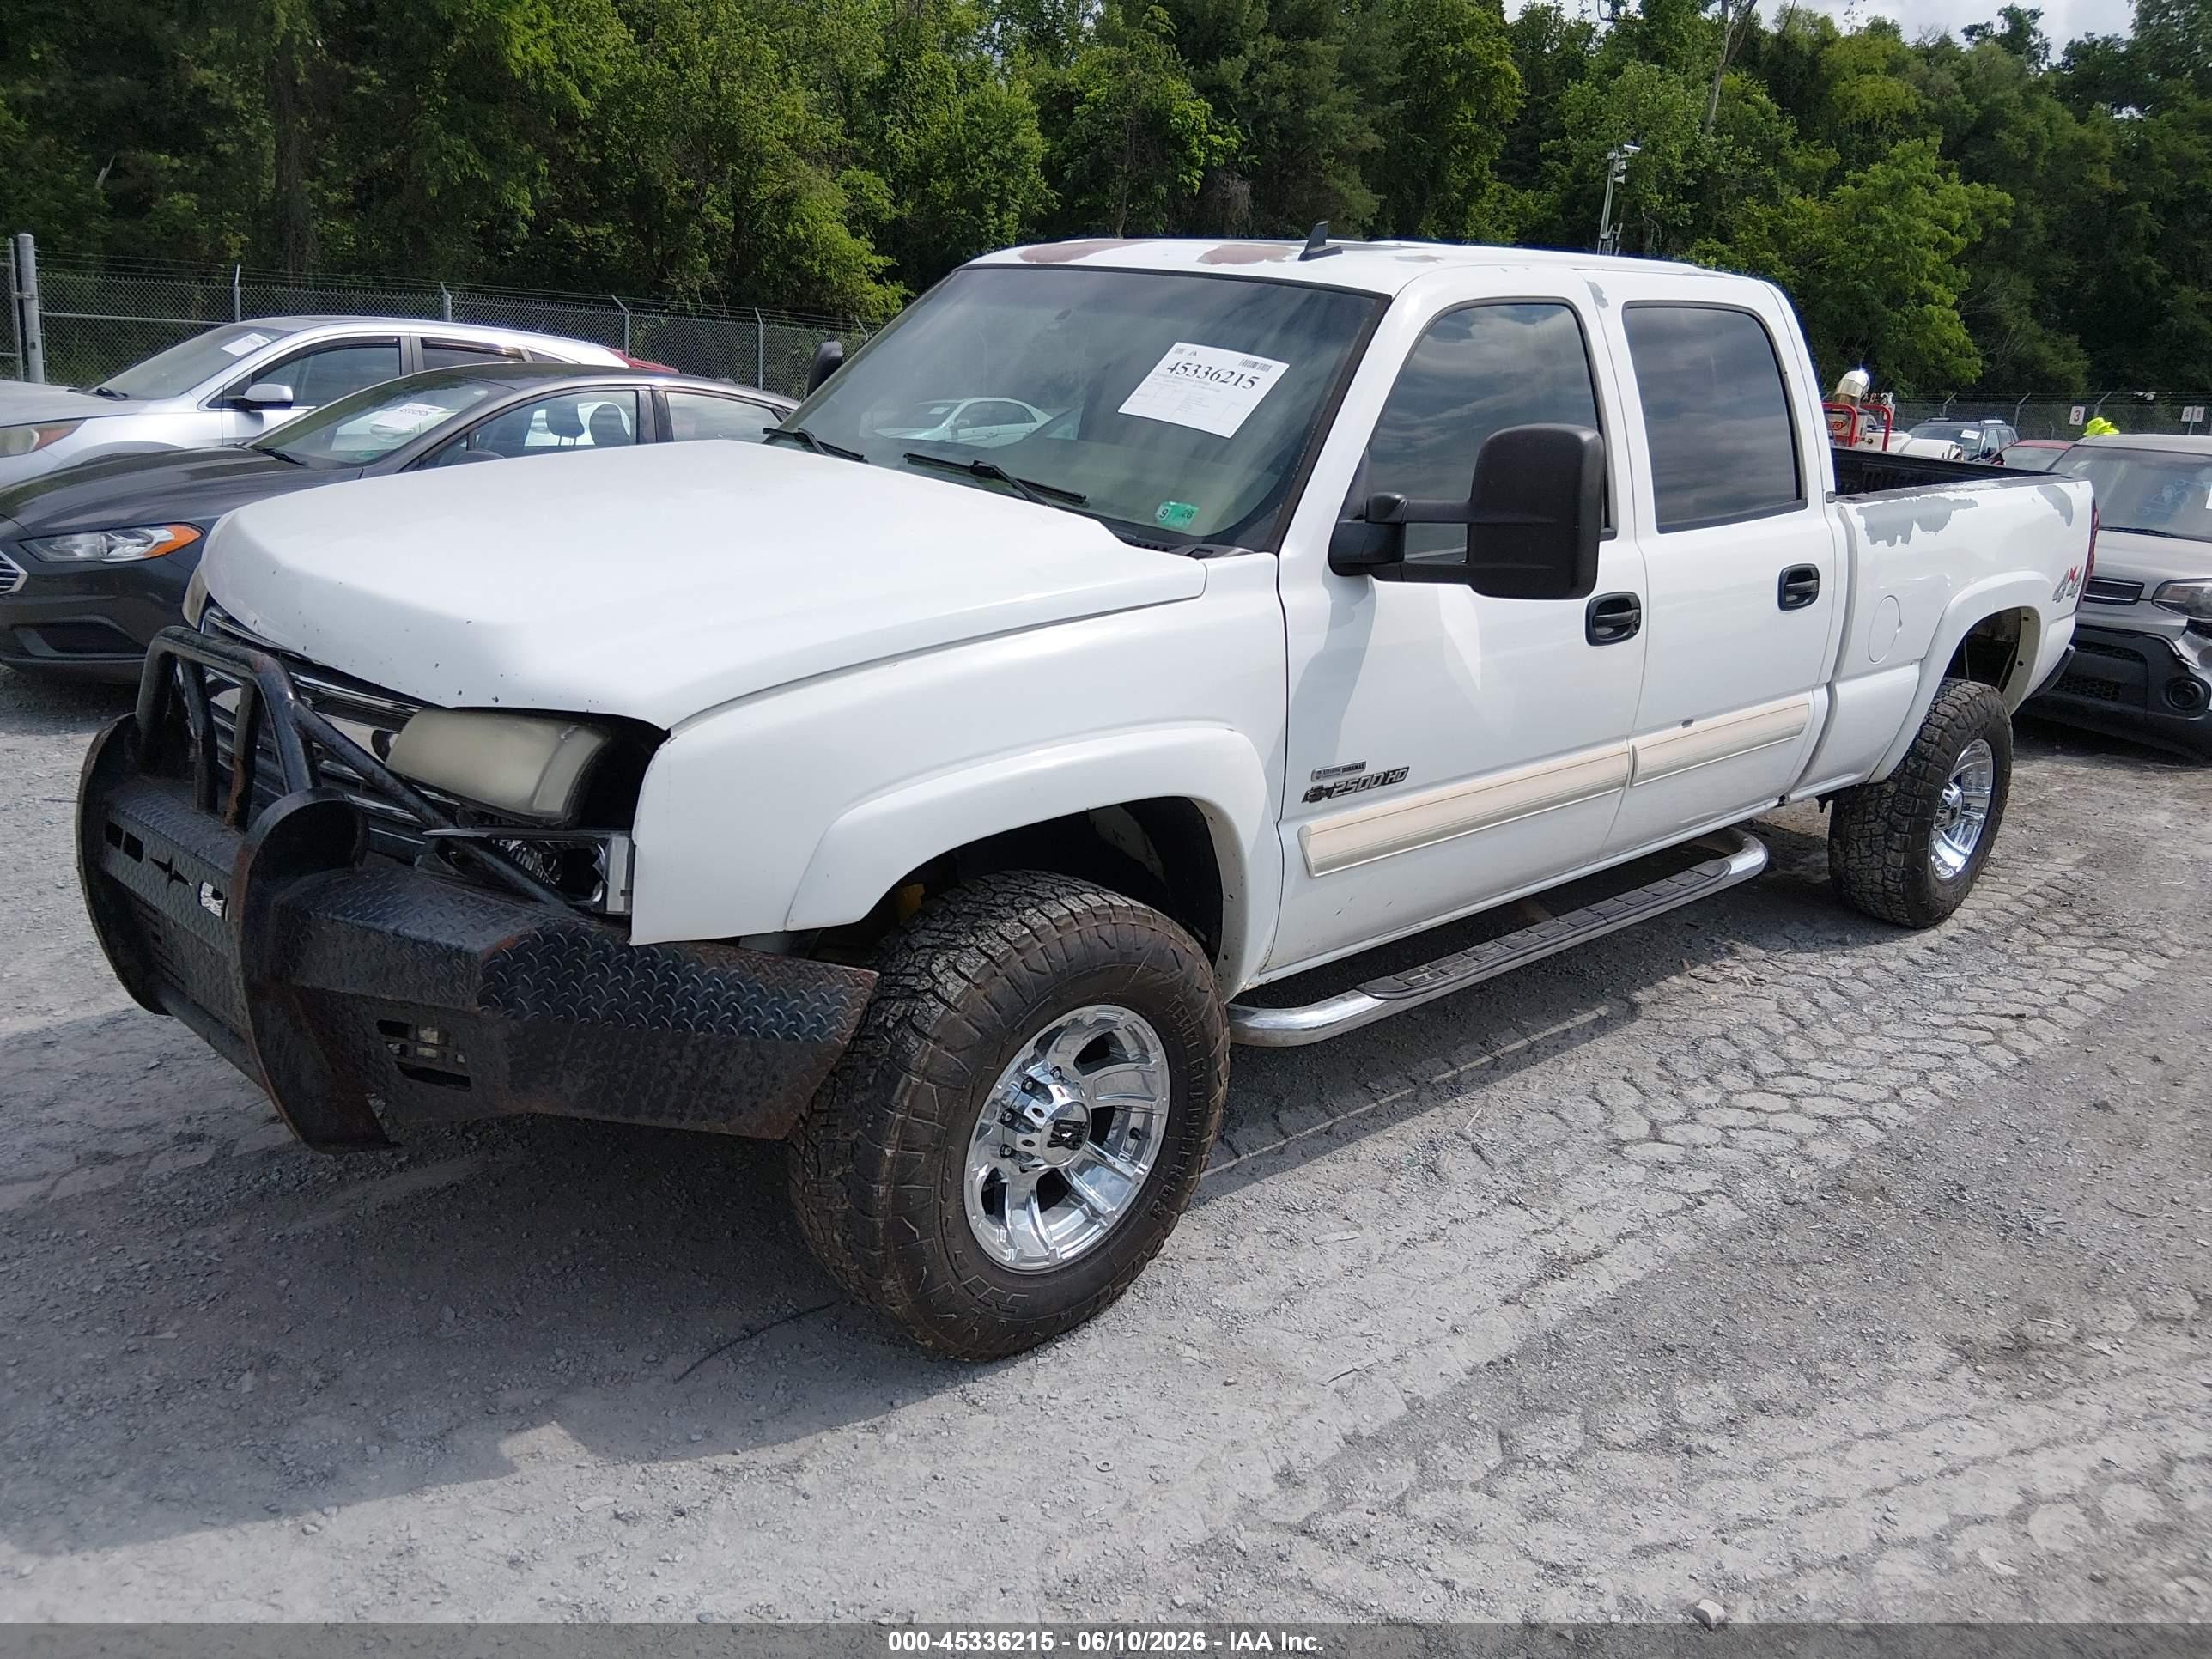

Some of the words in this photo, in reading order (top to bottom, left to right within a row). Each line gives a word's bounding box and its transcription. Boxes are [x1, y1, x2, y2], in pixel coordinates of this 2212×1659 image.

[1166, 360, 1261, 390] 45336215
[2073, 410, 2081, 422] 3
[1159, 507, 1169, 519] 9
